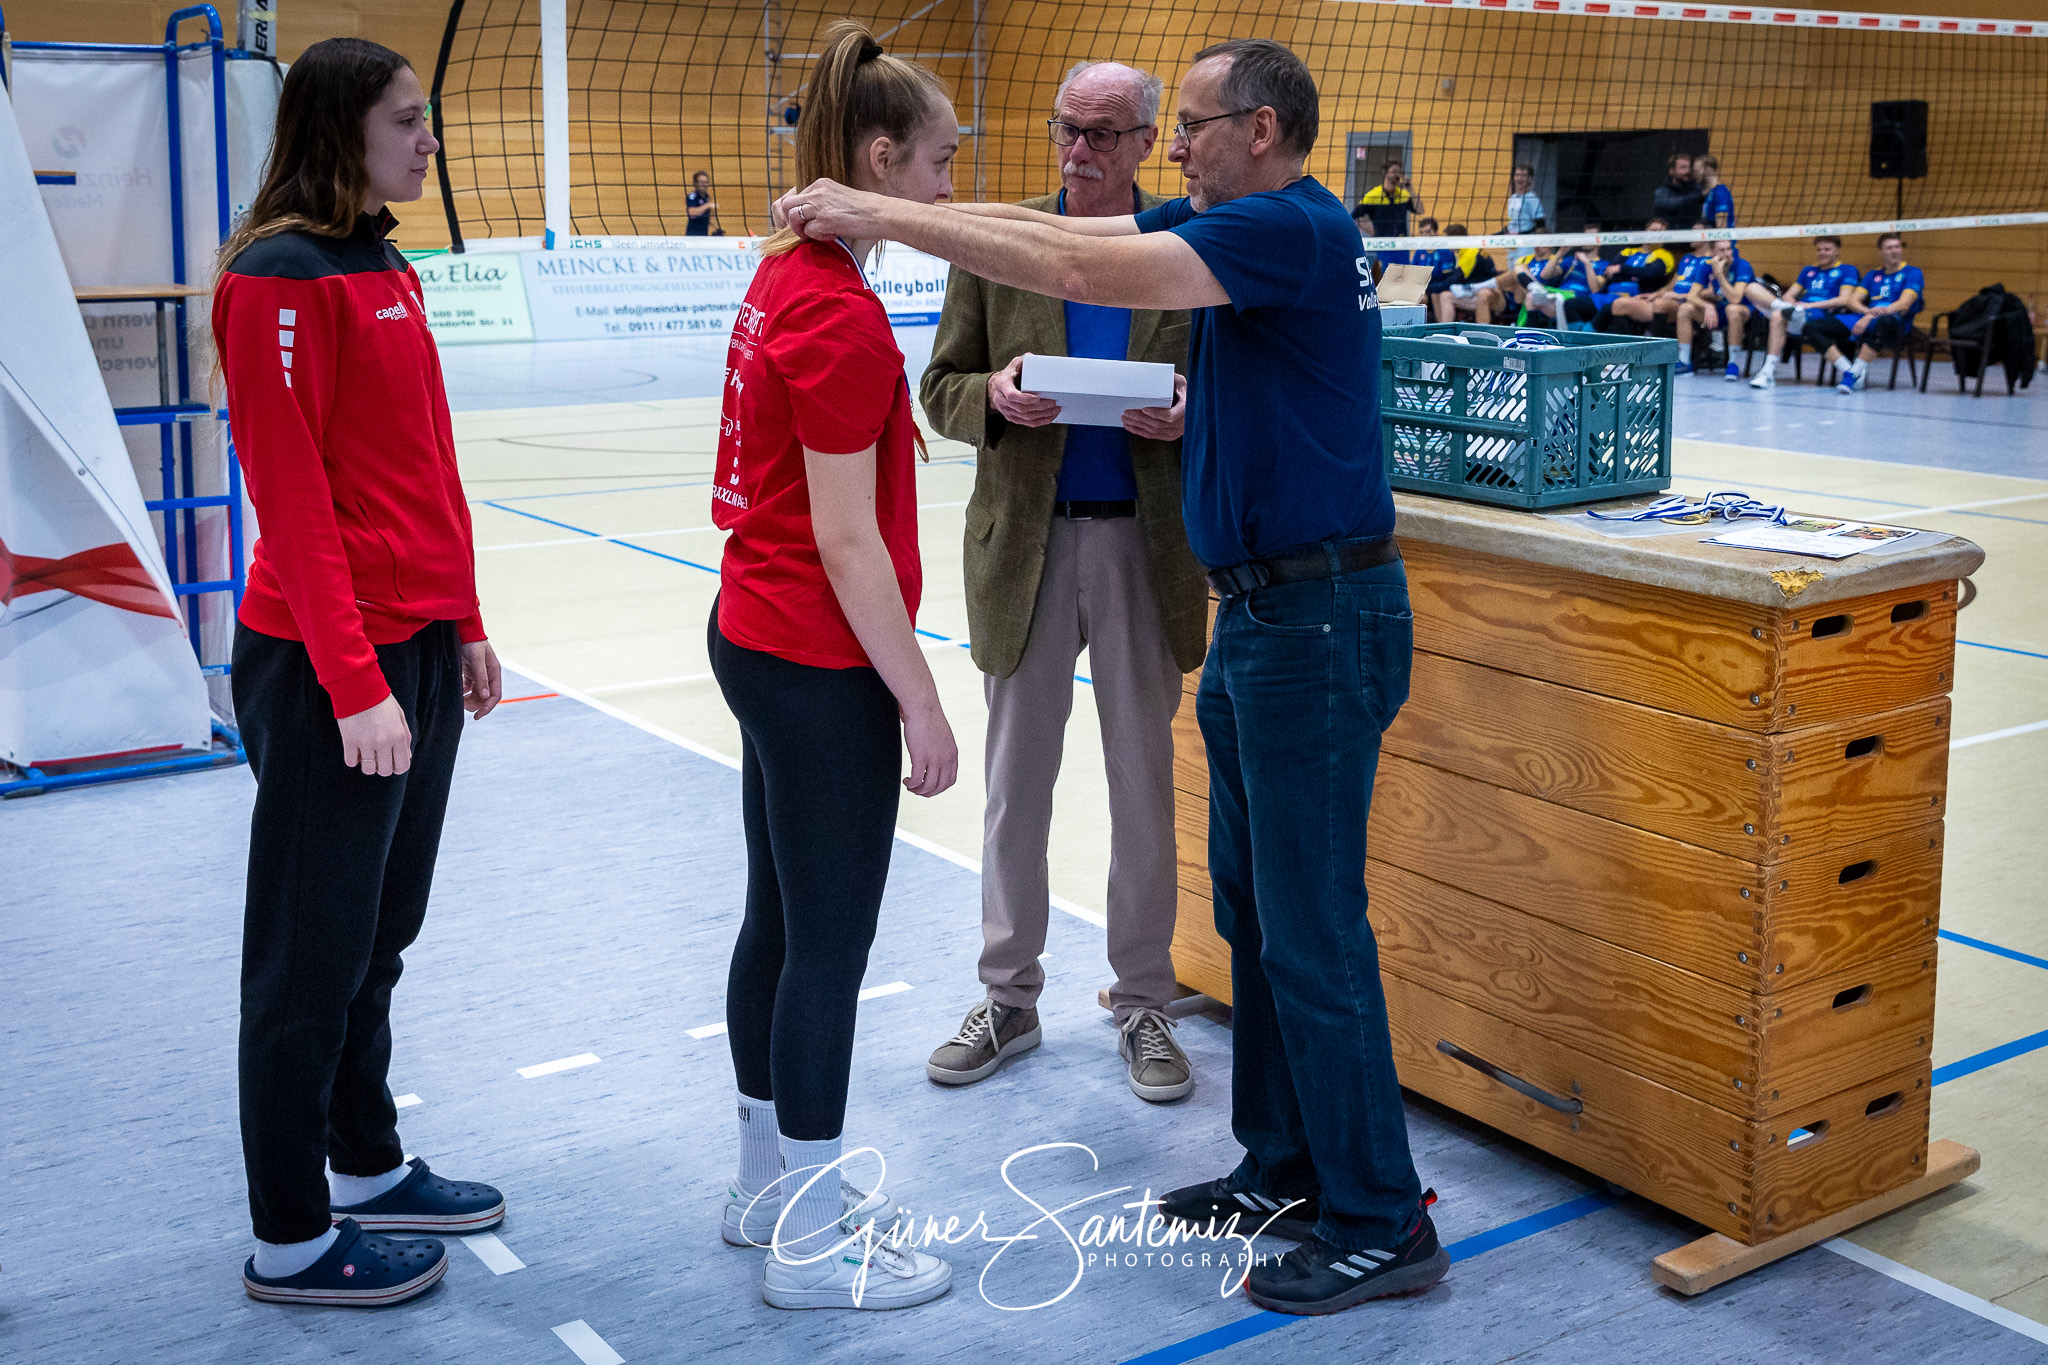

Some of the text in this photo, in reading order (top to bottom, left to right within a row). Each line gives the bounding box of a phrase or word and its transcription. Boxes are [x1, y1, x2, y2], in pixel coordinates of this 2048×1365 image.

[569, 239, 686, 249] UCHS Ideen umsetzen
[1366, 241, 1396, 249] FUCHS
[1489, 238, 1517, 246] FUCHS
[537, 253, 758, 275] MEINCKE & PARTNER
[419, 262, 509, 283] a Elia
[872, 279, 945, 297] olleyball
[628, 321, 655, 332] 0911
[666, 319, 684, 330] 477
